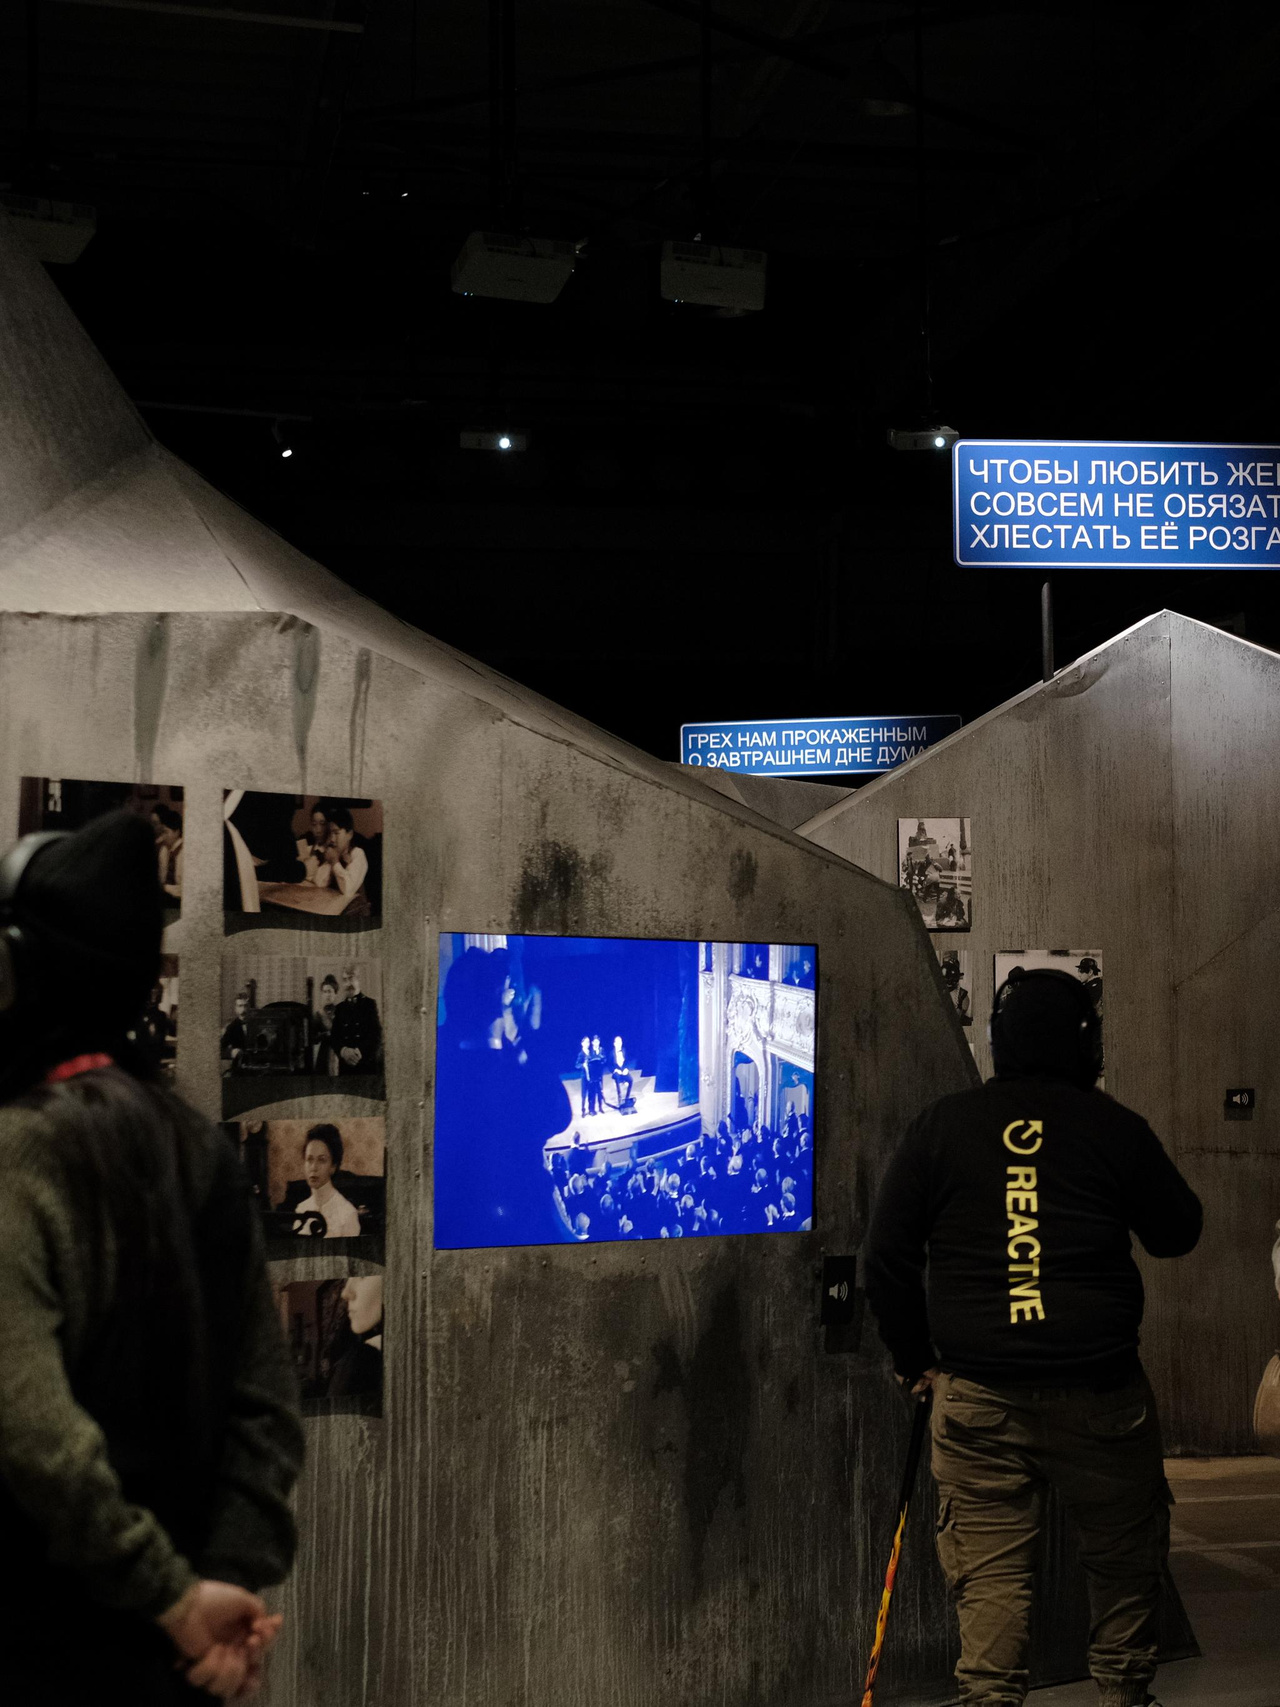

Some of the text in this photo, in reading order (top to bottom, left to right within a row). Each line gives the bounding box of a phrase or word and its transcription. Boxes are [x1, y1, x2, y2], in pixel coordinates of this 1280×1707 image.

[969, 459, 1079, 485] ЧТОБЫ
[1088, 460, 1219, 485] ЛЮБИТЬ
[970, 491, 1104, 517] СОВСЕМ
[1114, 493, 1154, 518] НЕ
[970, 524, 1131, 549] ХЛЕСТАТЬ
[1141, 521, 1179, 550] ЕЁ
[688, 726, 927, 749] ГРЕХ НАМ ПРОКАЖЕННЫМ
[688, 753, 702, 766] О
[706, 749, 830, 768] ЗАВТРАШНЕМ
[835, 747, 872, 767] ДНЕ
